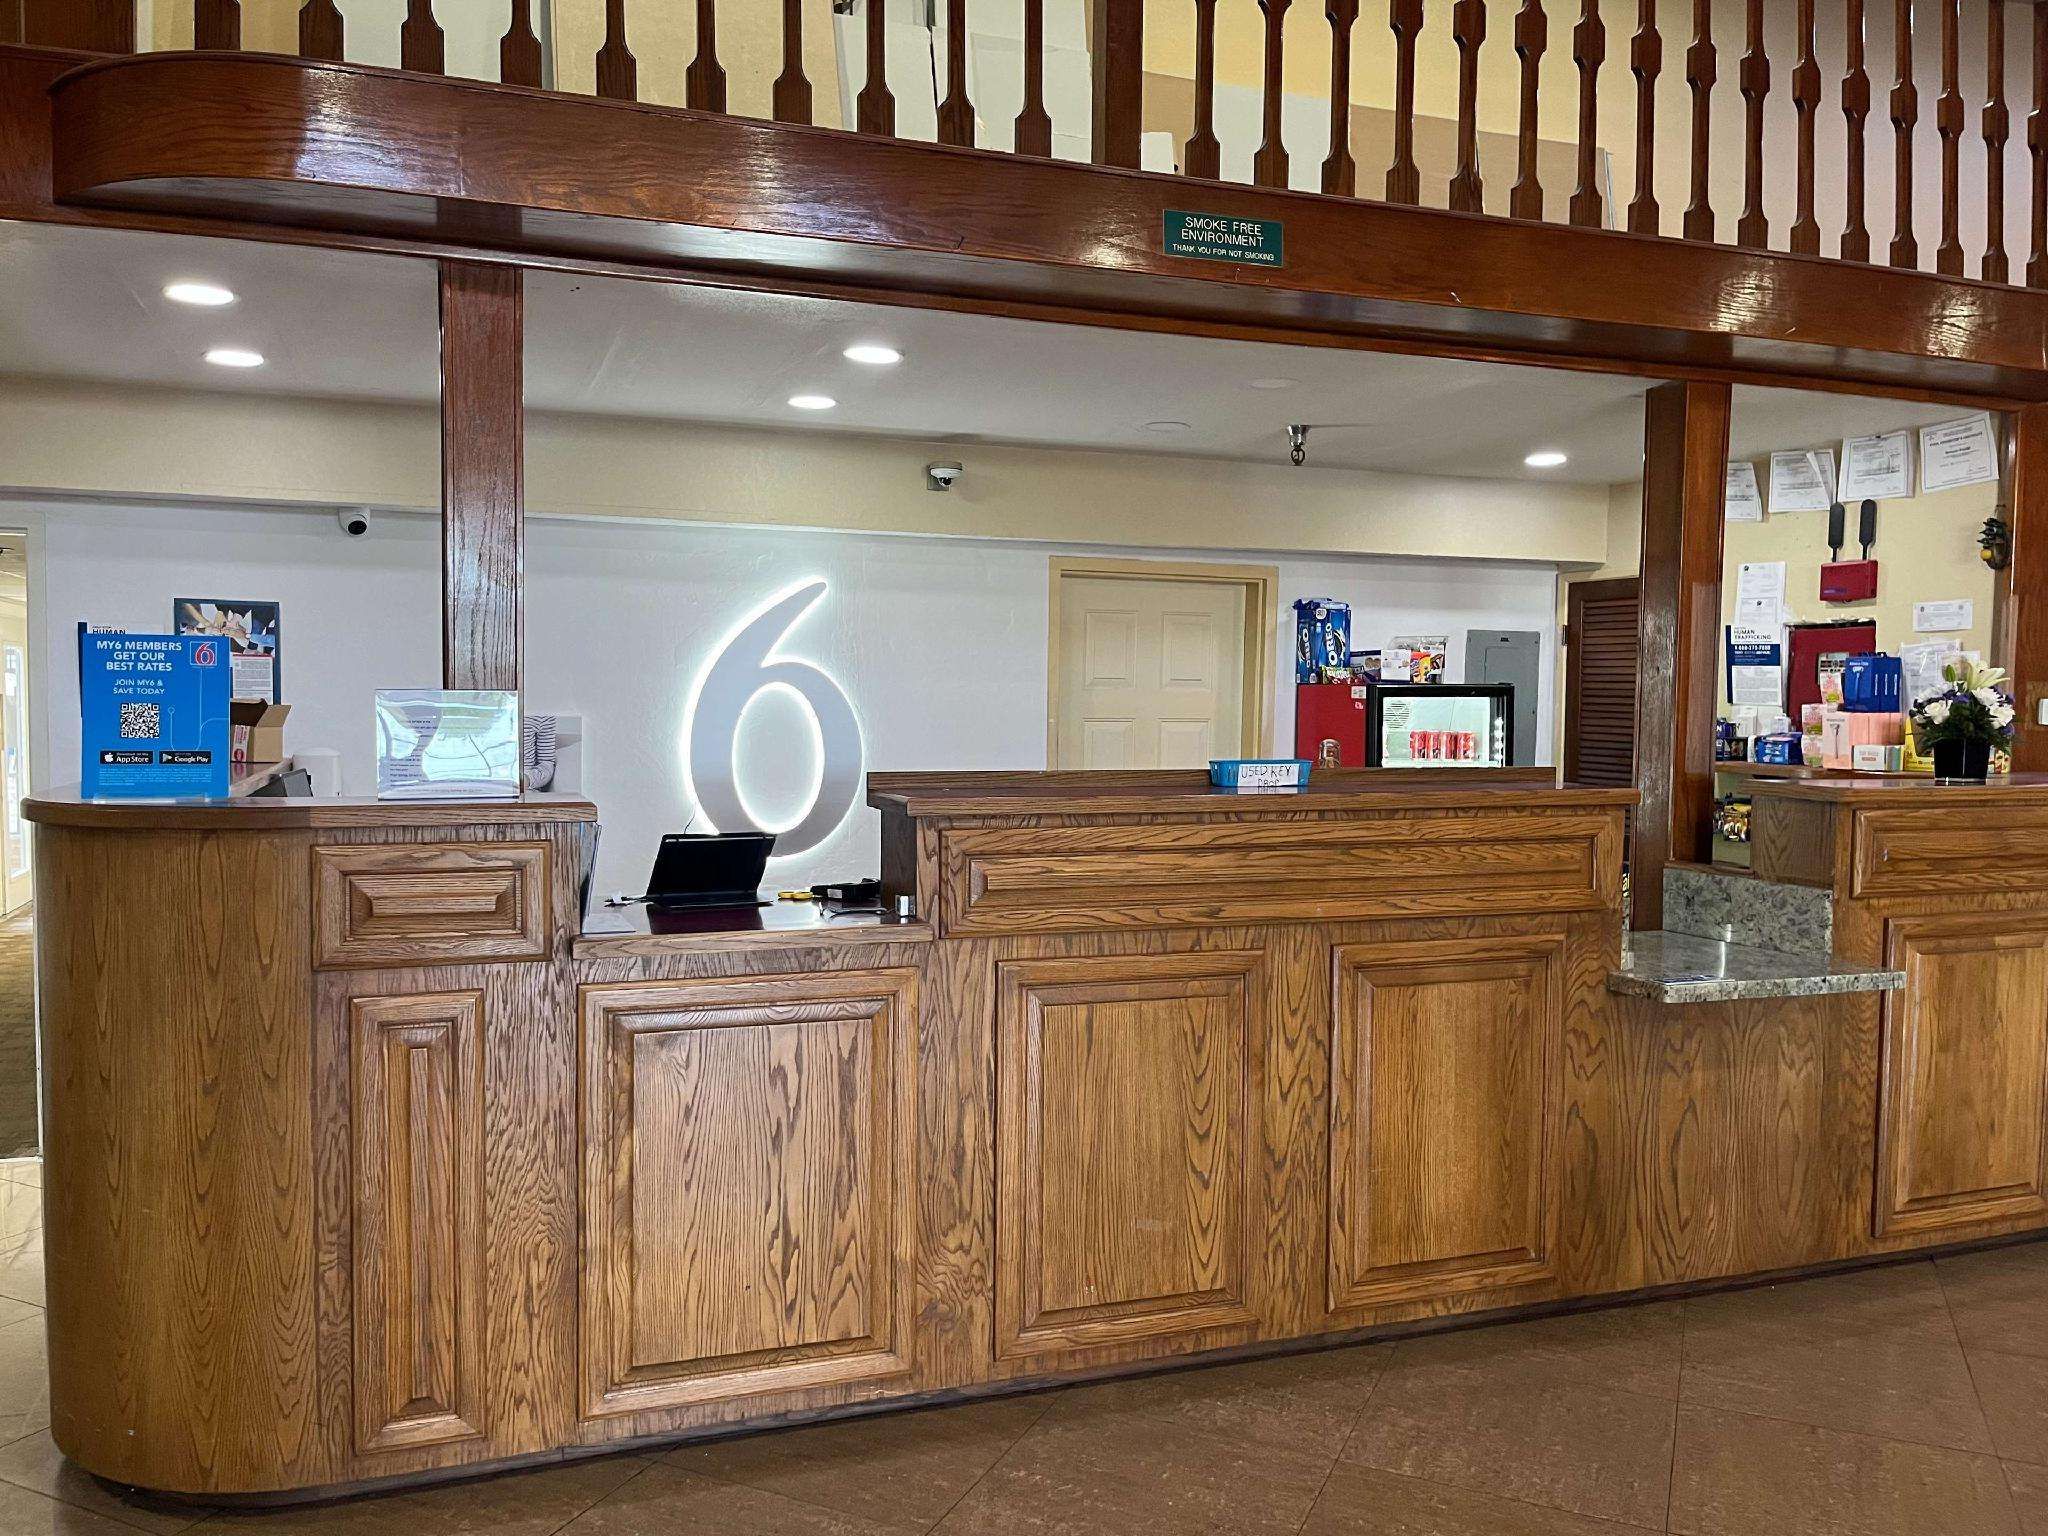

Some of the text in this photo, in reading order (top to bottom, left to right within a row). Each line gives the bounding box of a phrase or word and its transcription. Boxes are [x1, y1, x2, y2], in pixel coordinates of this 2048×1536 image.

[1185, 216, 1262, 236] SMOKE FREE
[1181, 229, 1264, 247] ENVIRONMENT
[1172, 243, 1275, 261] THANK YOU FOR NOT SMOKING
[96, 641, 182, 651] MY6 MEMBERS
[1326, 622, 1338, 666] OREO
[113, 651, 165, 661] GET OUR
[195, 642, 215, 664] 6
[106, 661, 173, 672] BEST RATES
[137, 679, 155, 687] MY6
[136, 687, 165, 695] TODAY
[690, 581, 863, 858] 6
[174, 756, 209, 764] Google Play
[1241, 766, 1293, 779] USED KEY
